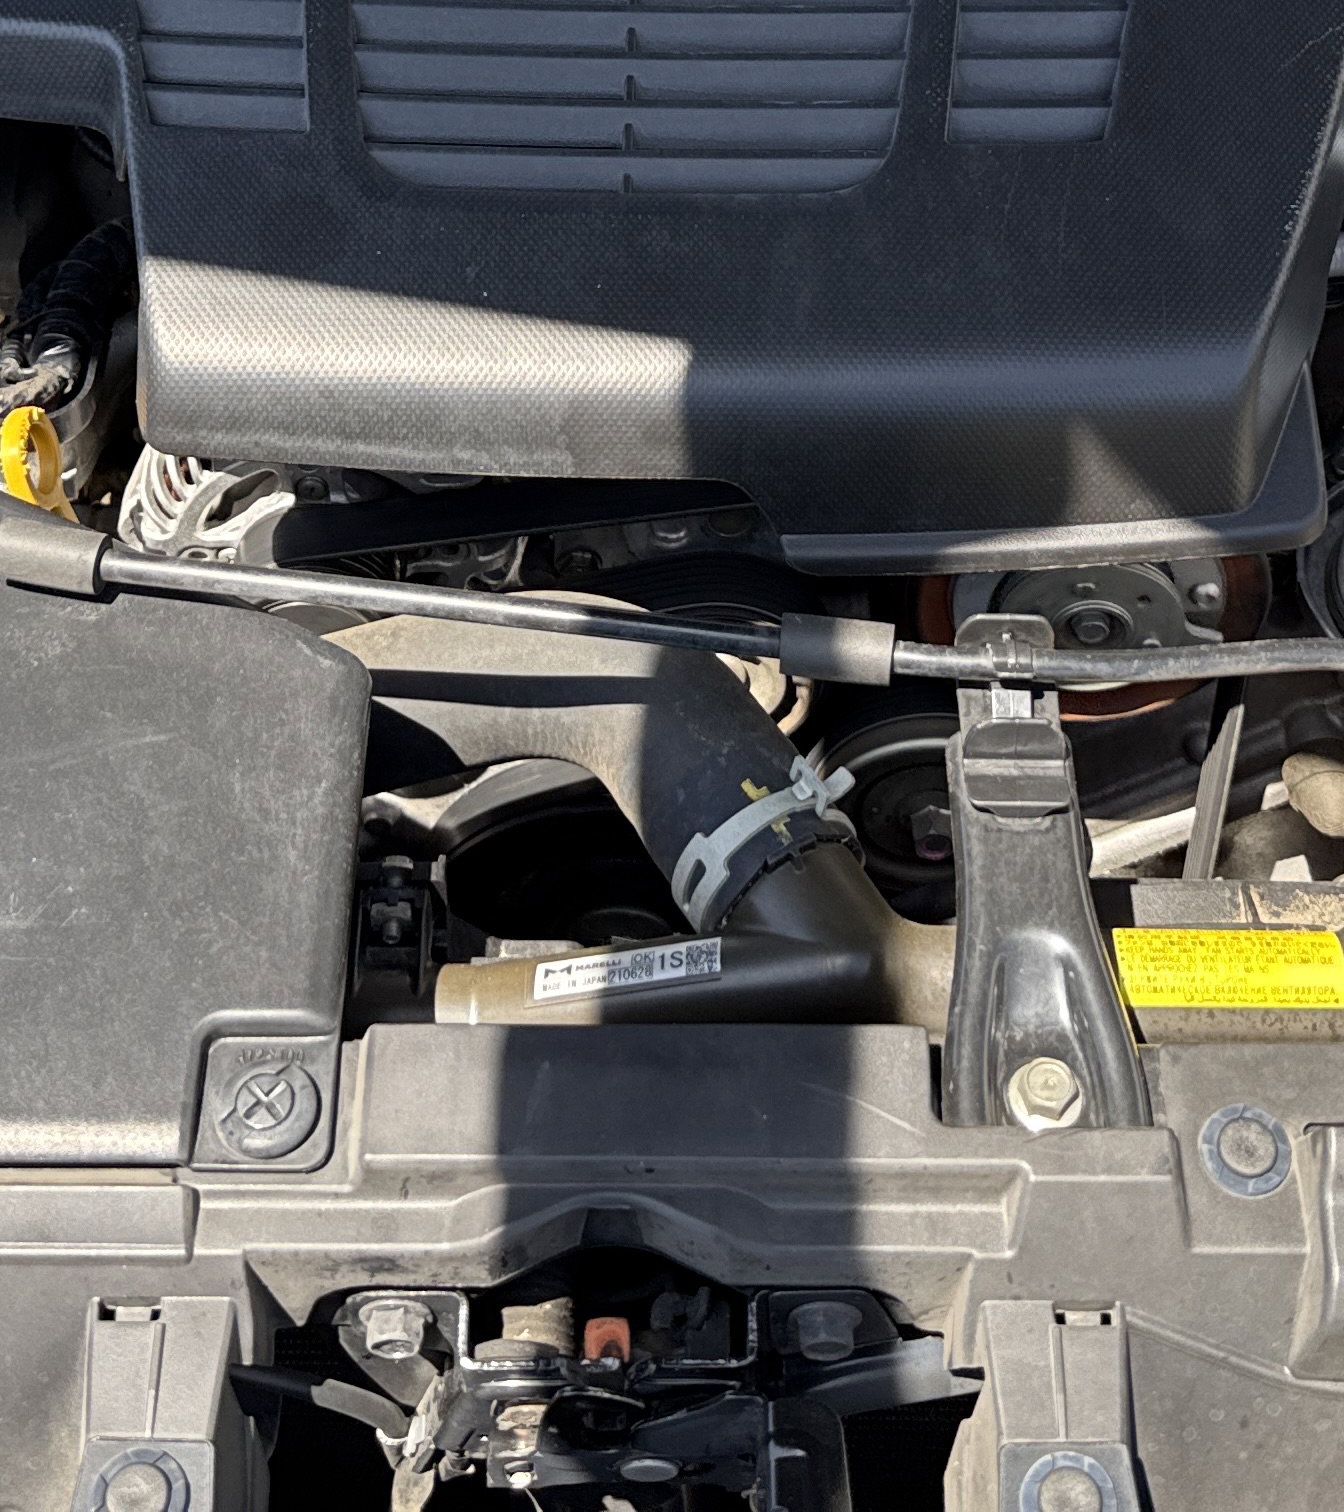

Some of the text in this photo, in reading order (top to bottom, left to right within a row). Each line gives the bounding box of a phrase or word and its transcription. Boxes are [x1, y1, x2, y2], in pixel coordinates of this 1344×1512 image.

[575, 959, 622, 971] MARELLI
[1283, 957, 1334, 965] AUTOMATIQUE
[542, 966, 652, 992] MADE IN JAPAN 210628
